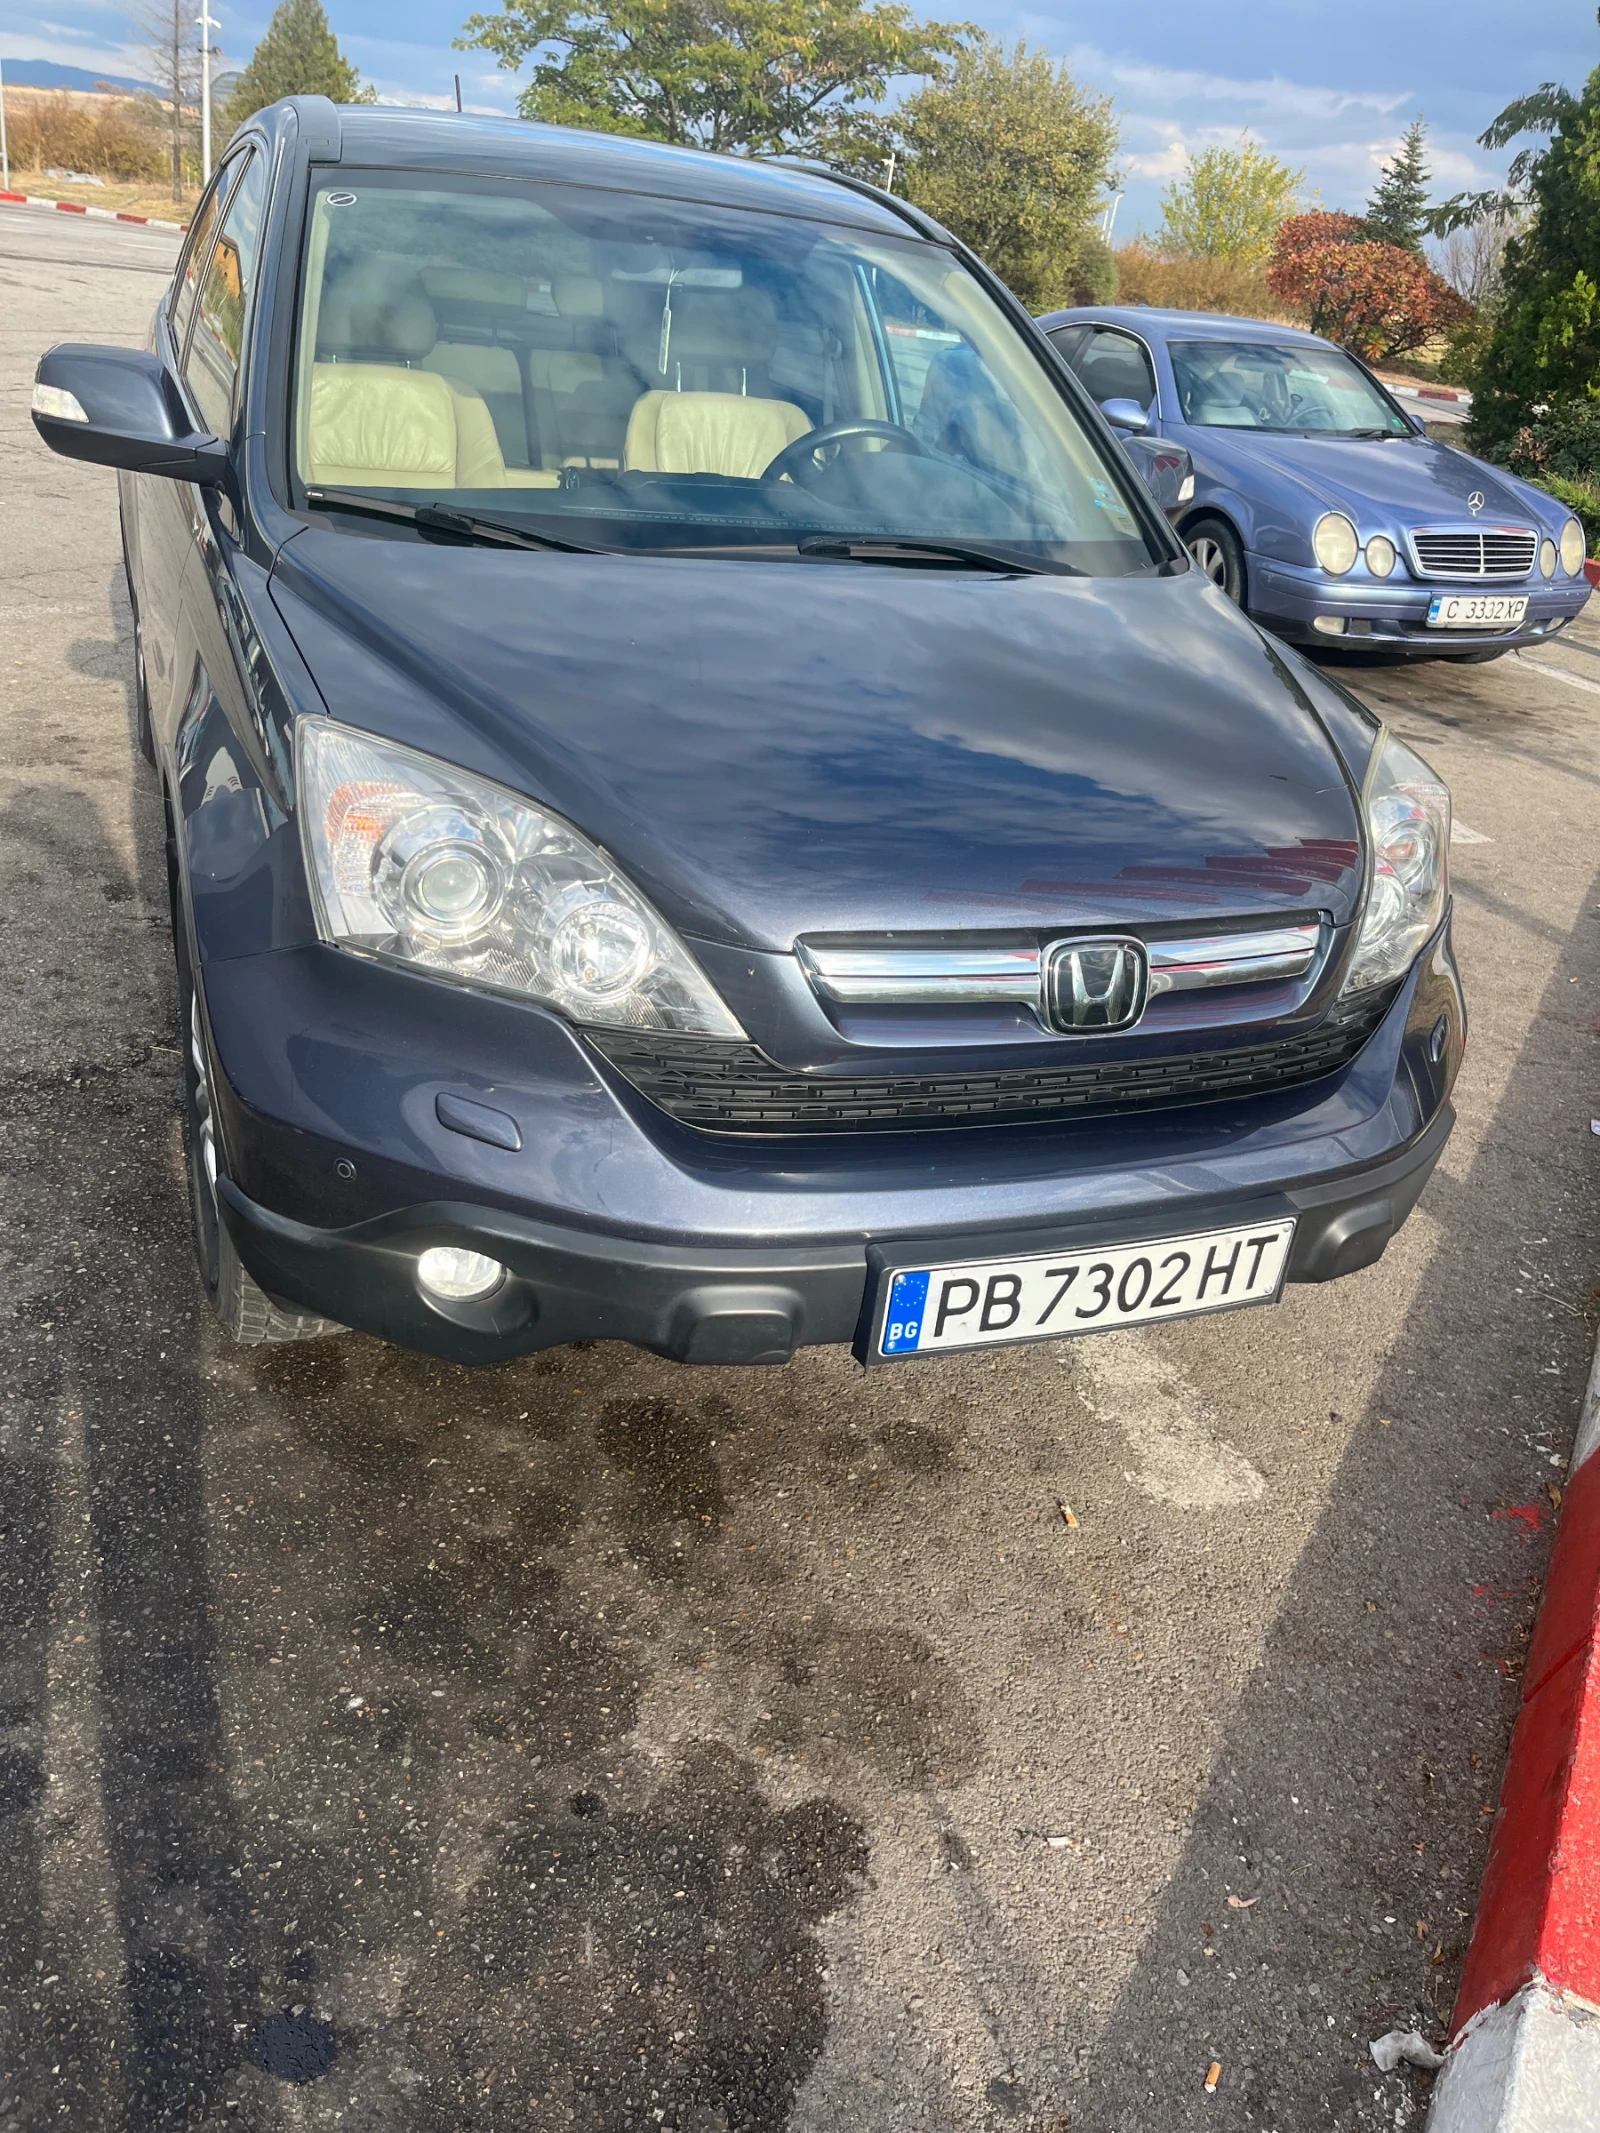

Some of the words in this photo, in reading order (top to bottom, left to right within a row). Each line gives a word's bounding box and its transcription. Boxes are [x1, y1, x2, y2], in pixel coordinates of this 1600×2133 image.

[1446, 600, 1460, 619] C
[933, 1273, 1023, 1338] PB
[1035, 1251, 1192, 1326] 7302
[889, 1321, 918, 1340] BG
